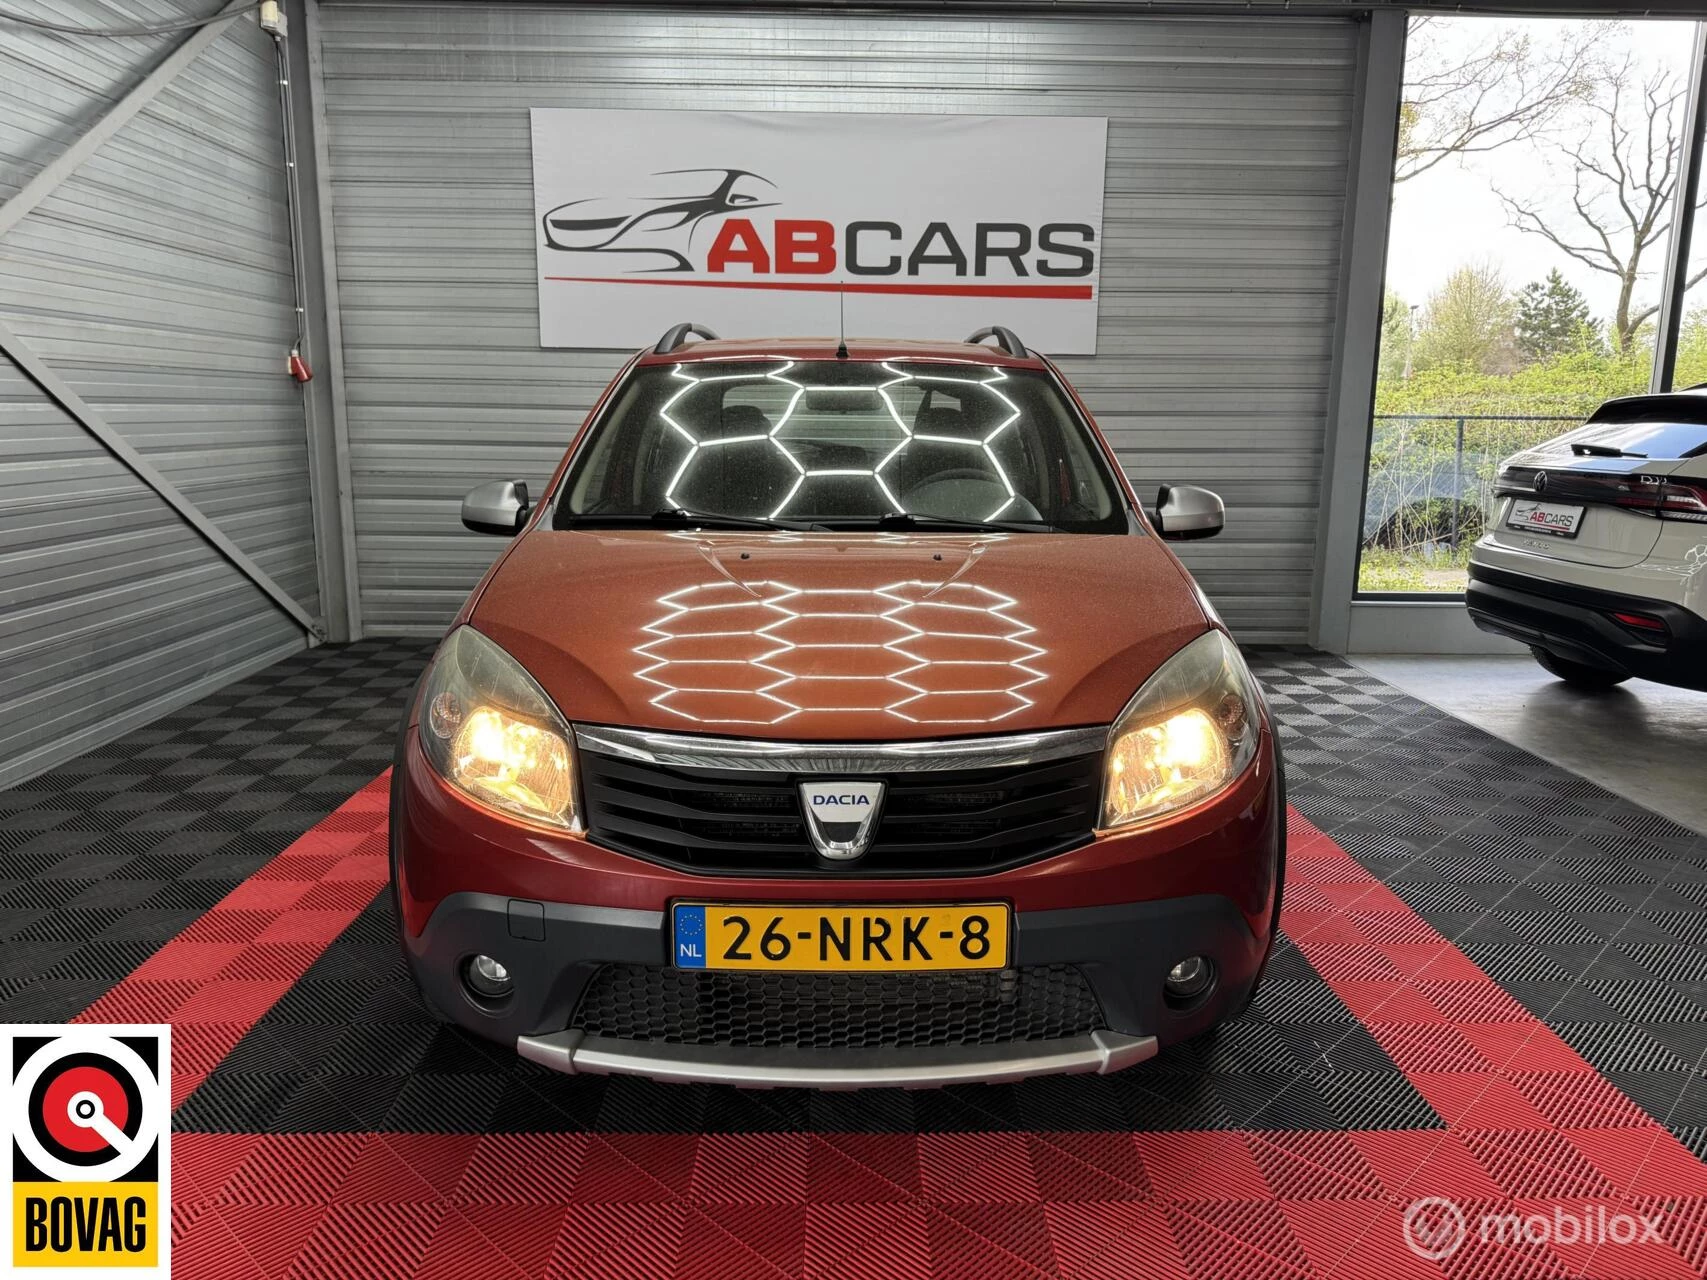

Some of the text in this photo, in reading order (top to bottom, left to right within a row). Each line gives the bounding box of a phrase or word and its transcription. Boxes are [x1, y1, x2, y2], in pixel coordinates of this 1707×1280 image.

[813, 795, 870, 805] DACIA
[722, 914, 990, 962] 26-NRK-8
[680, 943, 702, 958] NL
